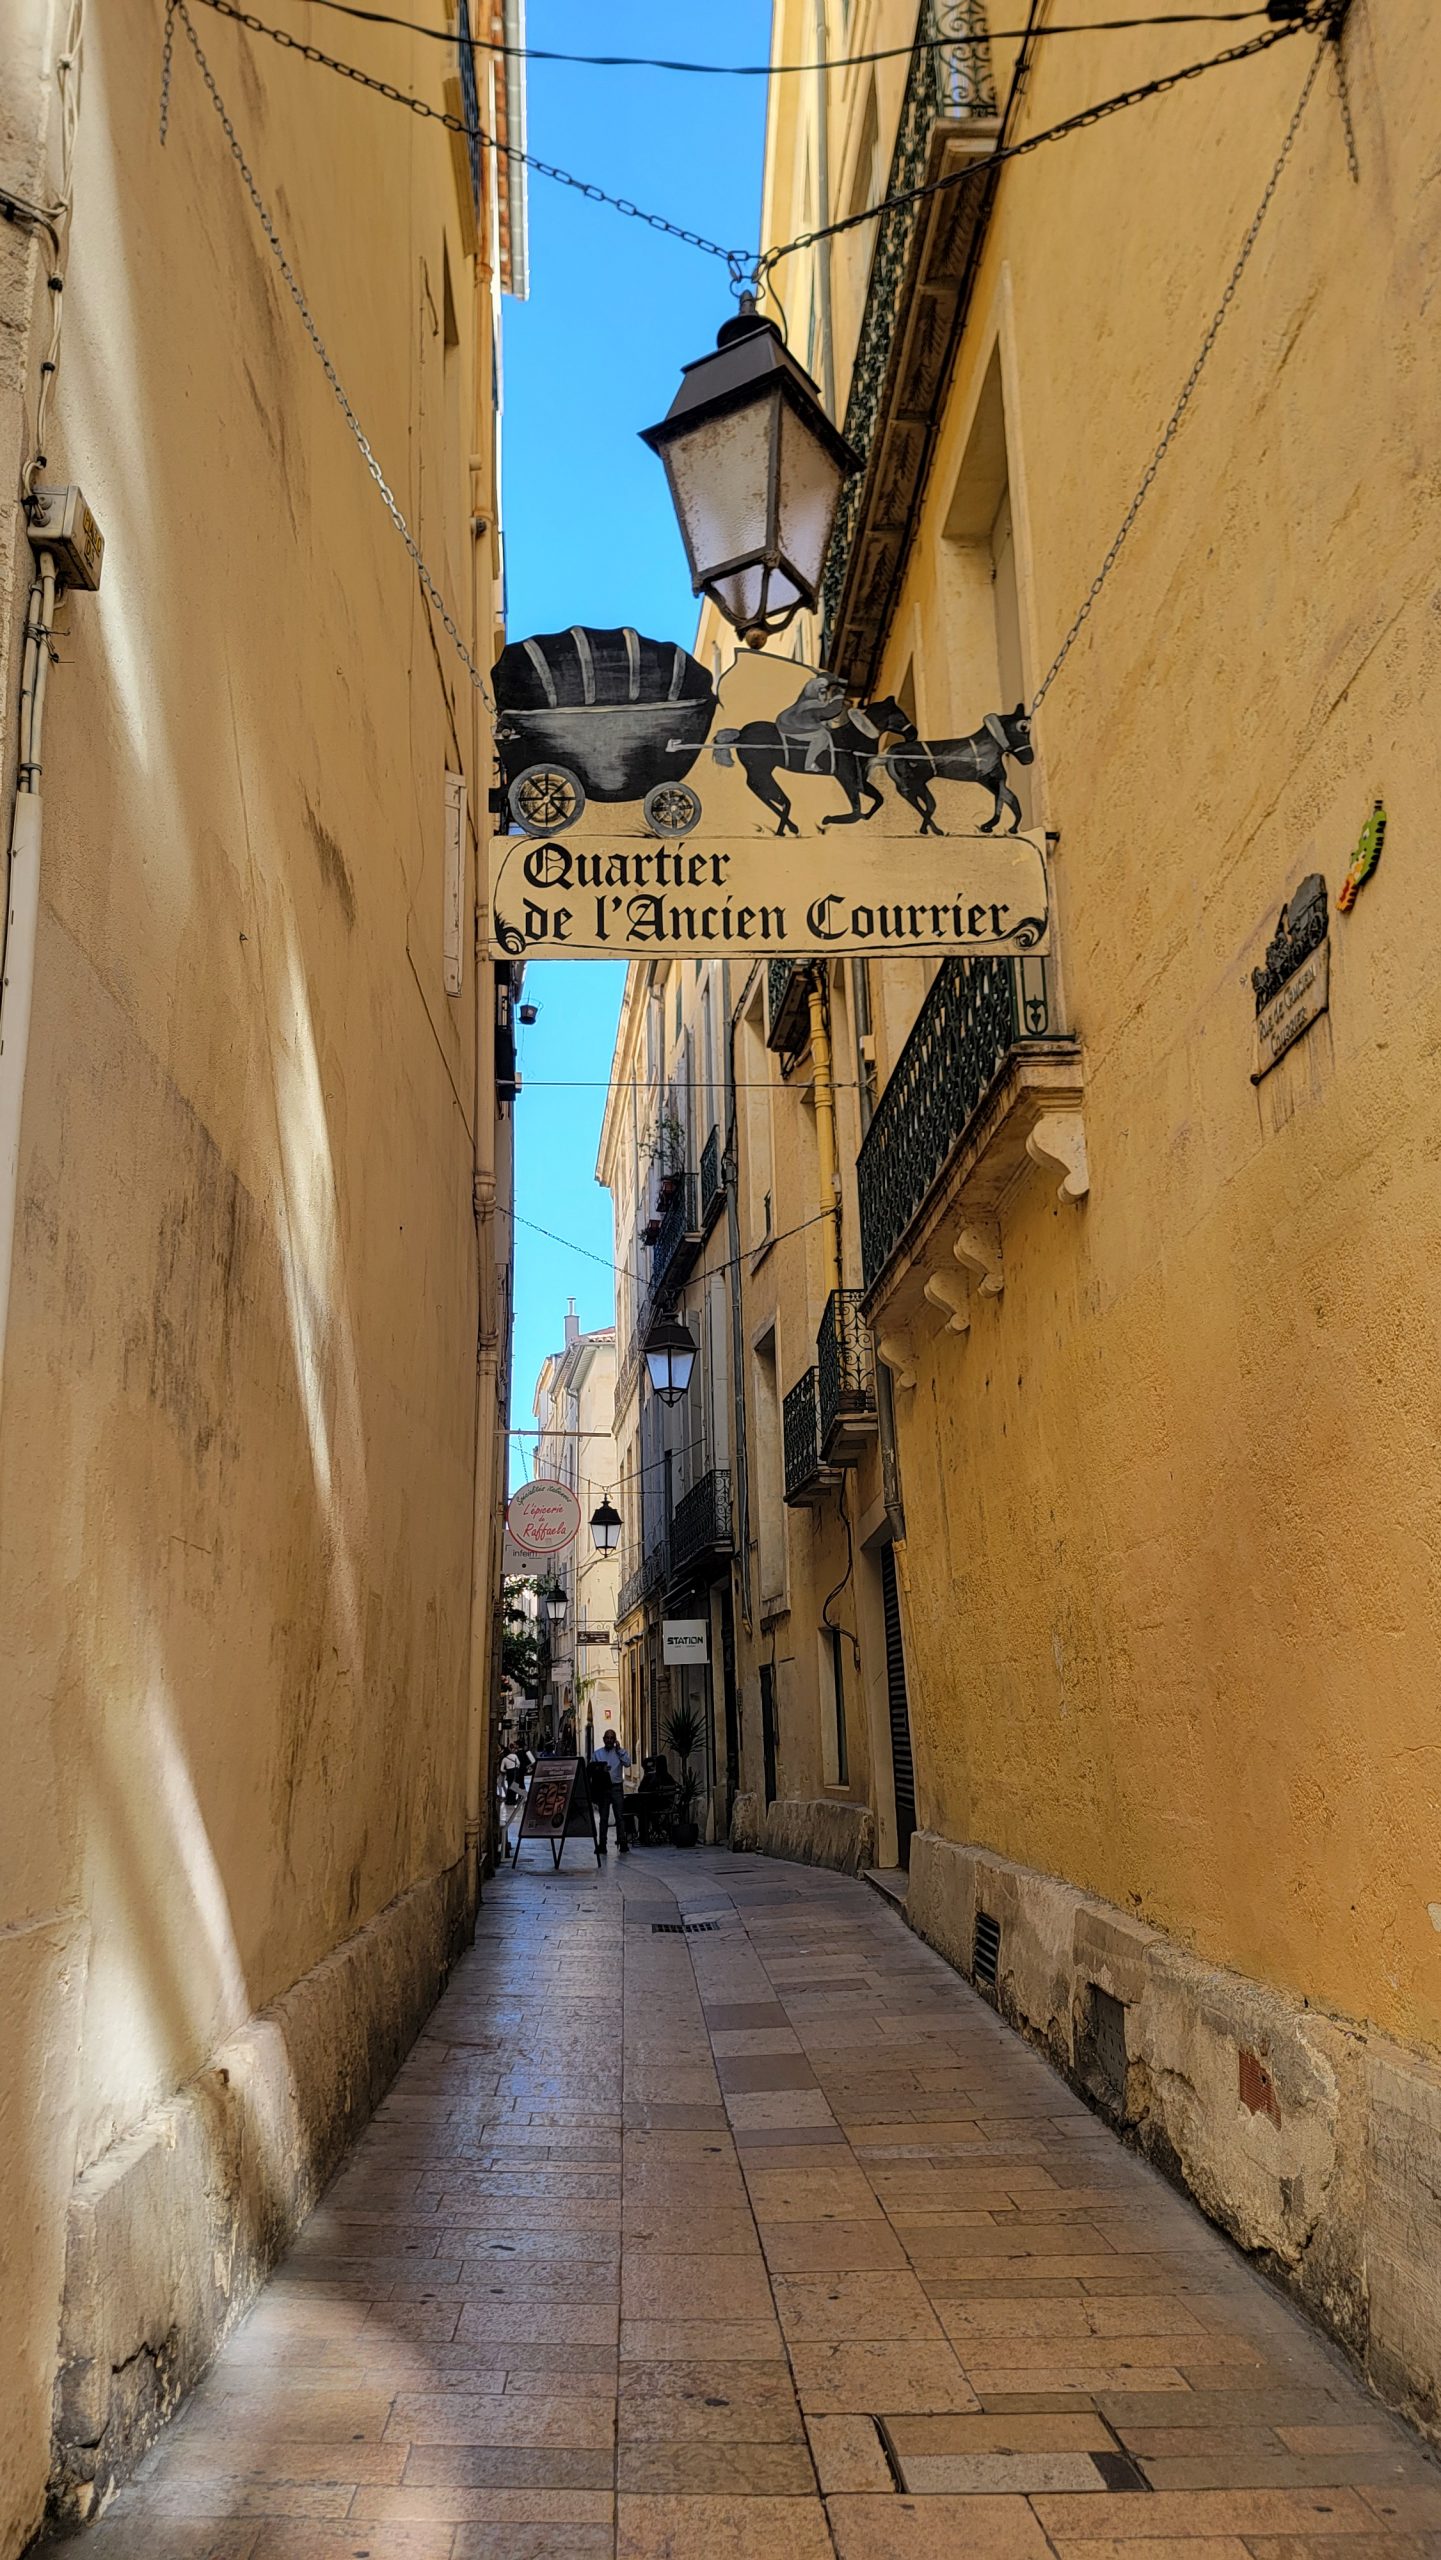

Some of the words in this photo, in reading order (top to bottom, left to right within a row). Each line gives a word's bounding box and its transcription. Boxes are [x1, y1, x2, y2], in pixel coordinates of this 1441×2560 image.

[524, 842, 731, 890] Quartier
[524, 898, 573, 941] de
[595, 894, 788, 942] l'Ancien
[806, 894, 1010, 941] Courrier
[523, 1522, 566, 1540] Raffaela
[667, 1636, 703, 1645] STATION
